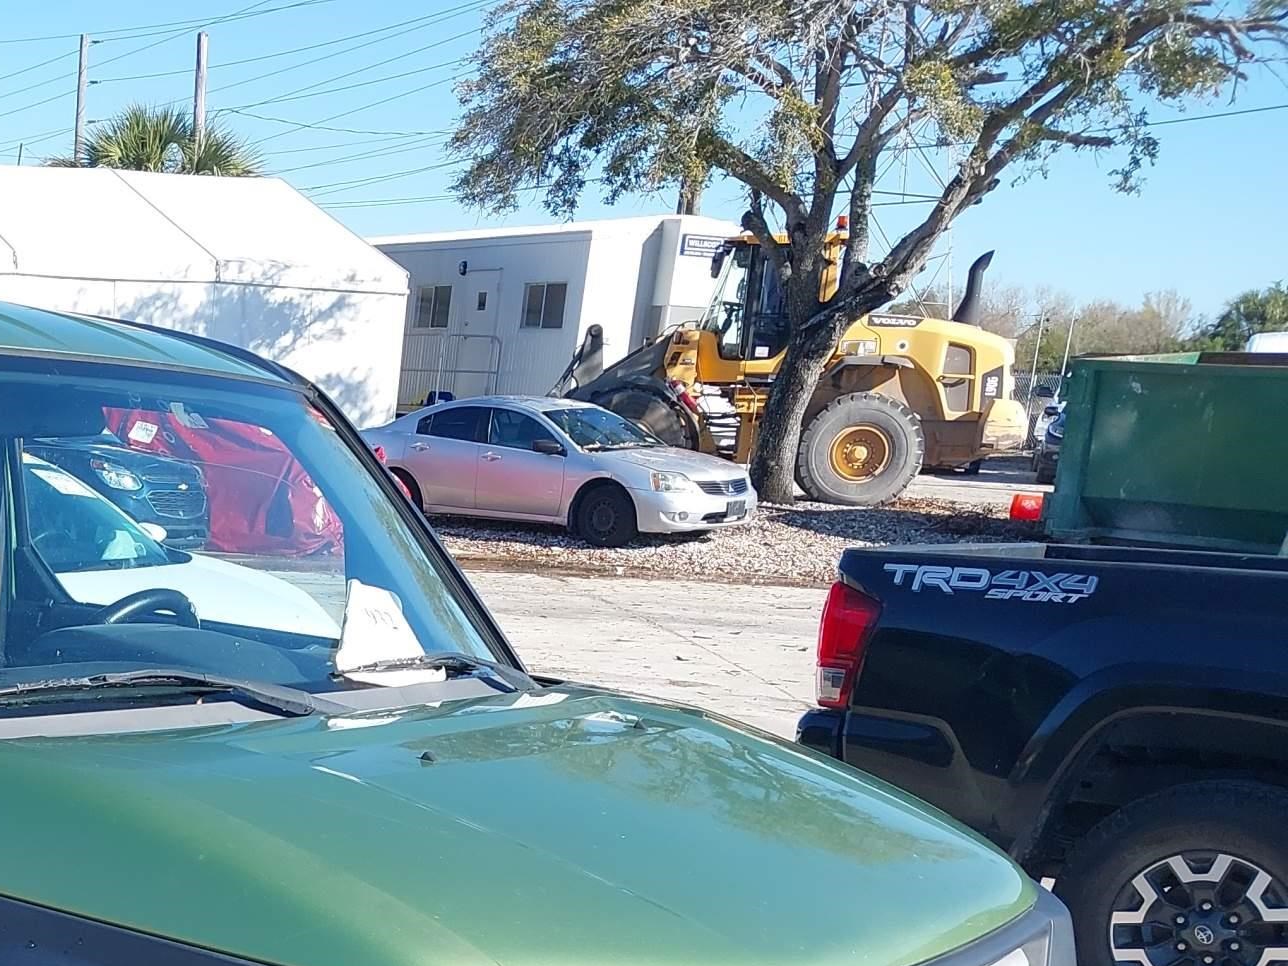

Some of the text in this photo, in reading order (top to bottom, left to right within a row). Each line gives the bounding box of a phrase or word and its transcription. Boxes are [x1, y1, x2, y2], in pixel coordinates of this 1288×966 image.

[871, 316, 918, 326] VOLVO
[883, 563, 992, 595] TRD
[984, 588, 1089, 604] SPORT
